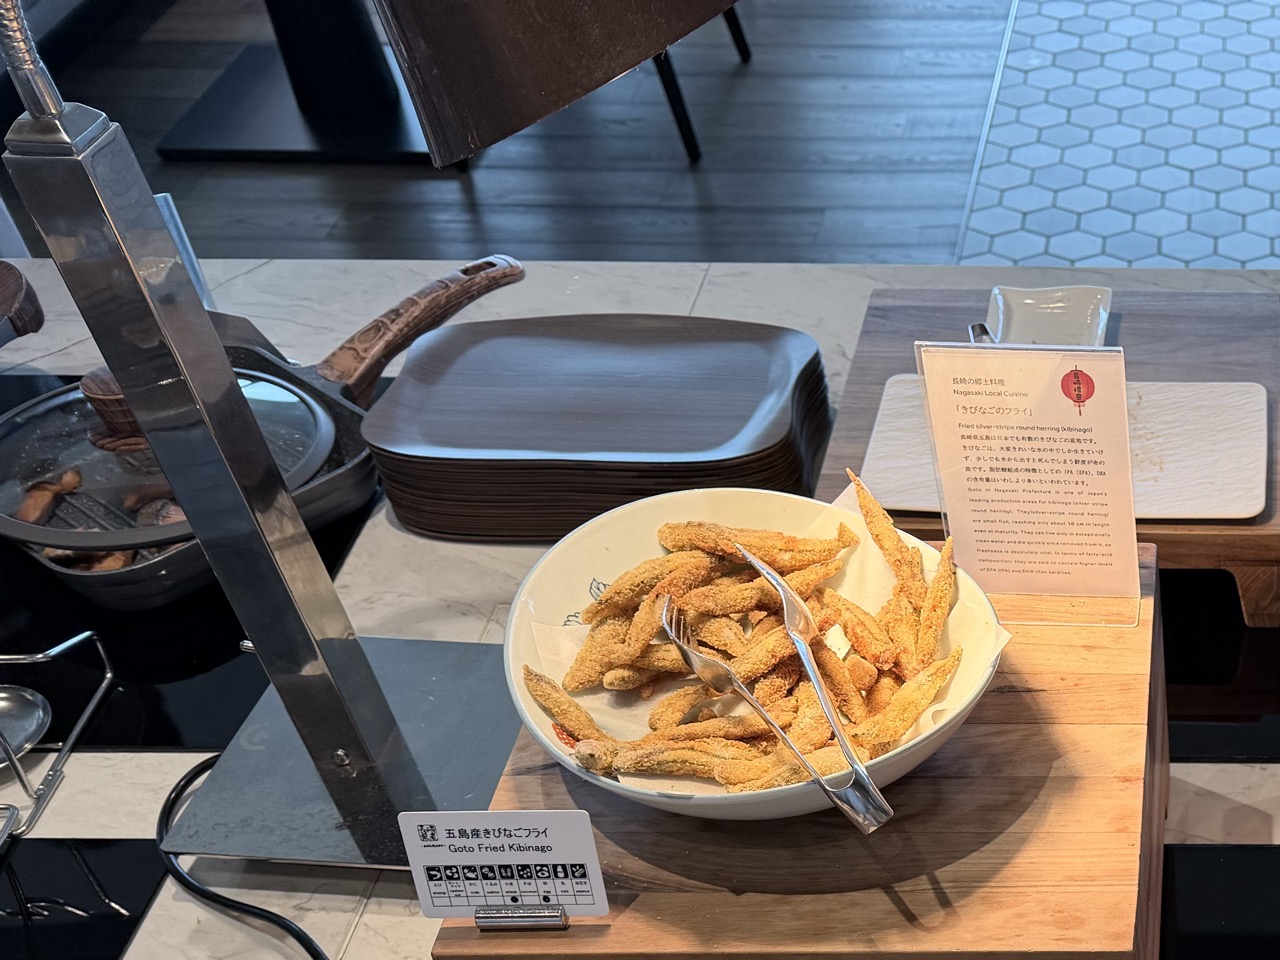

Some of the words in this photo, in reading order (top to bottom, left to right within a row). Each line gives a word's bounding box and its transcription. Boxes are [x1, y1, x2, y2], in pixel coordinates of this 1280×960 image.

[952, 378, 1005, 386] 長崎の郷土料理
[444, 827, 548, 839] 五島産きびなごフライ
[448, 844, 474, 852] Goto
[477, 843, 505, 852] Fried
[508, 843, 552, 852] Kibinago
